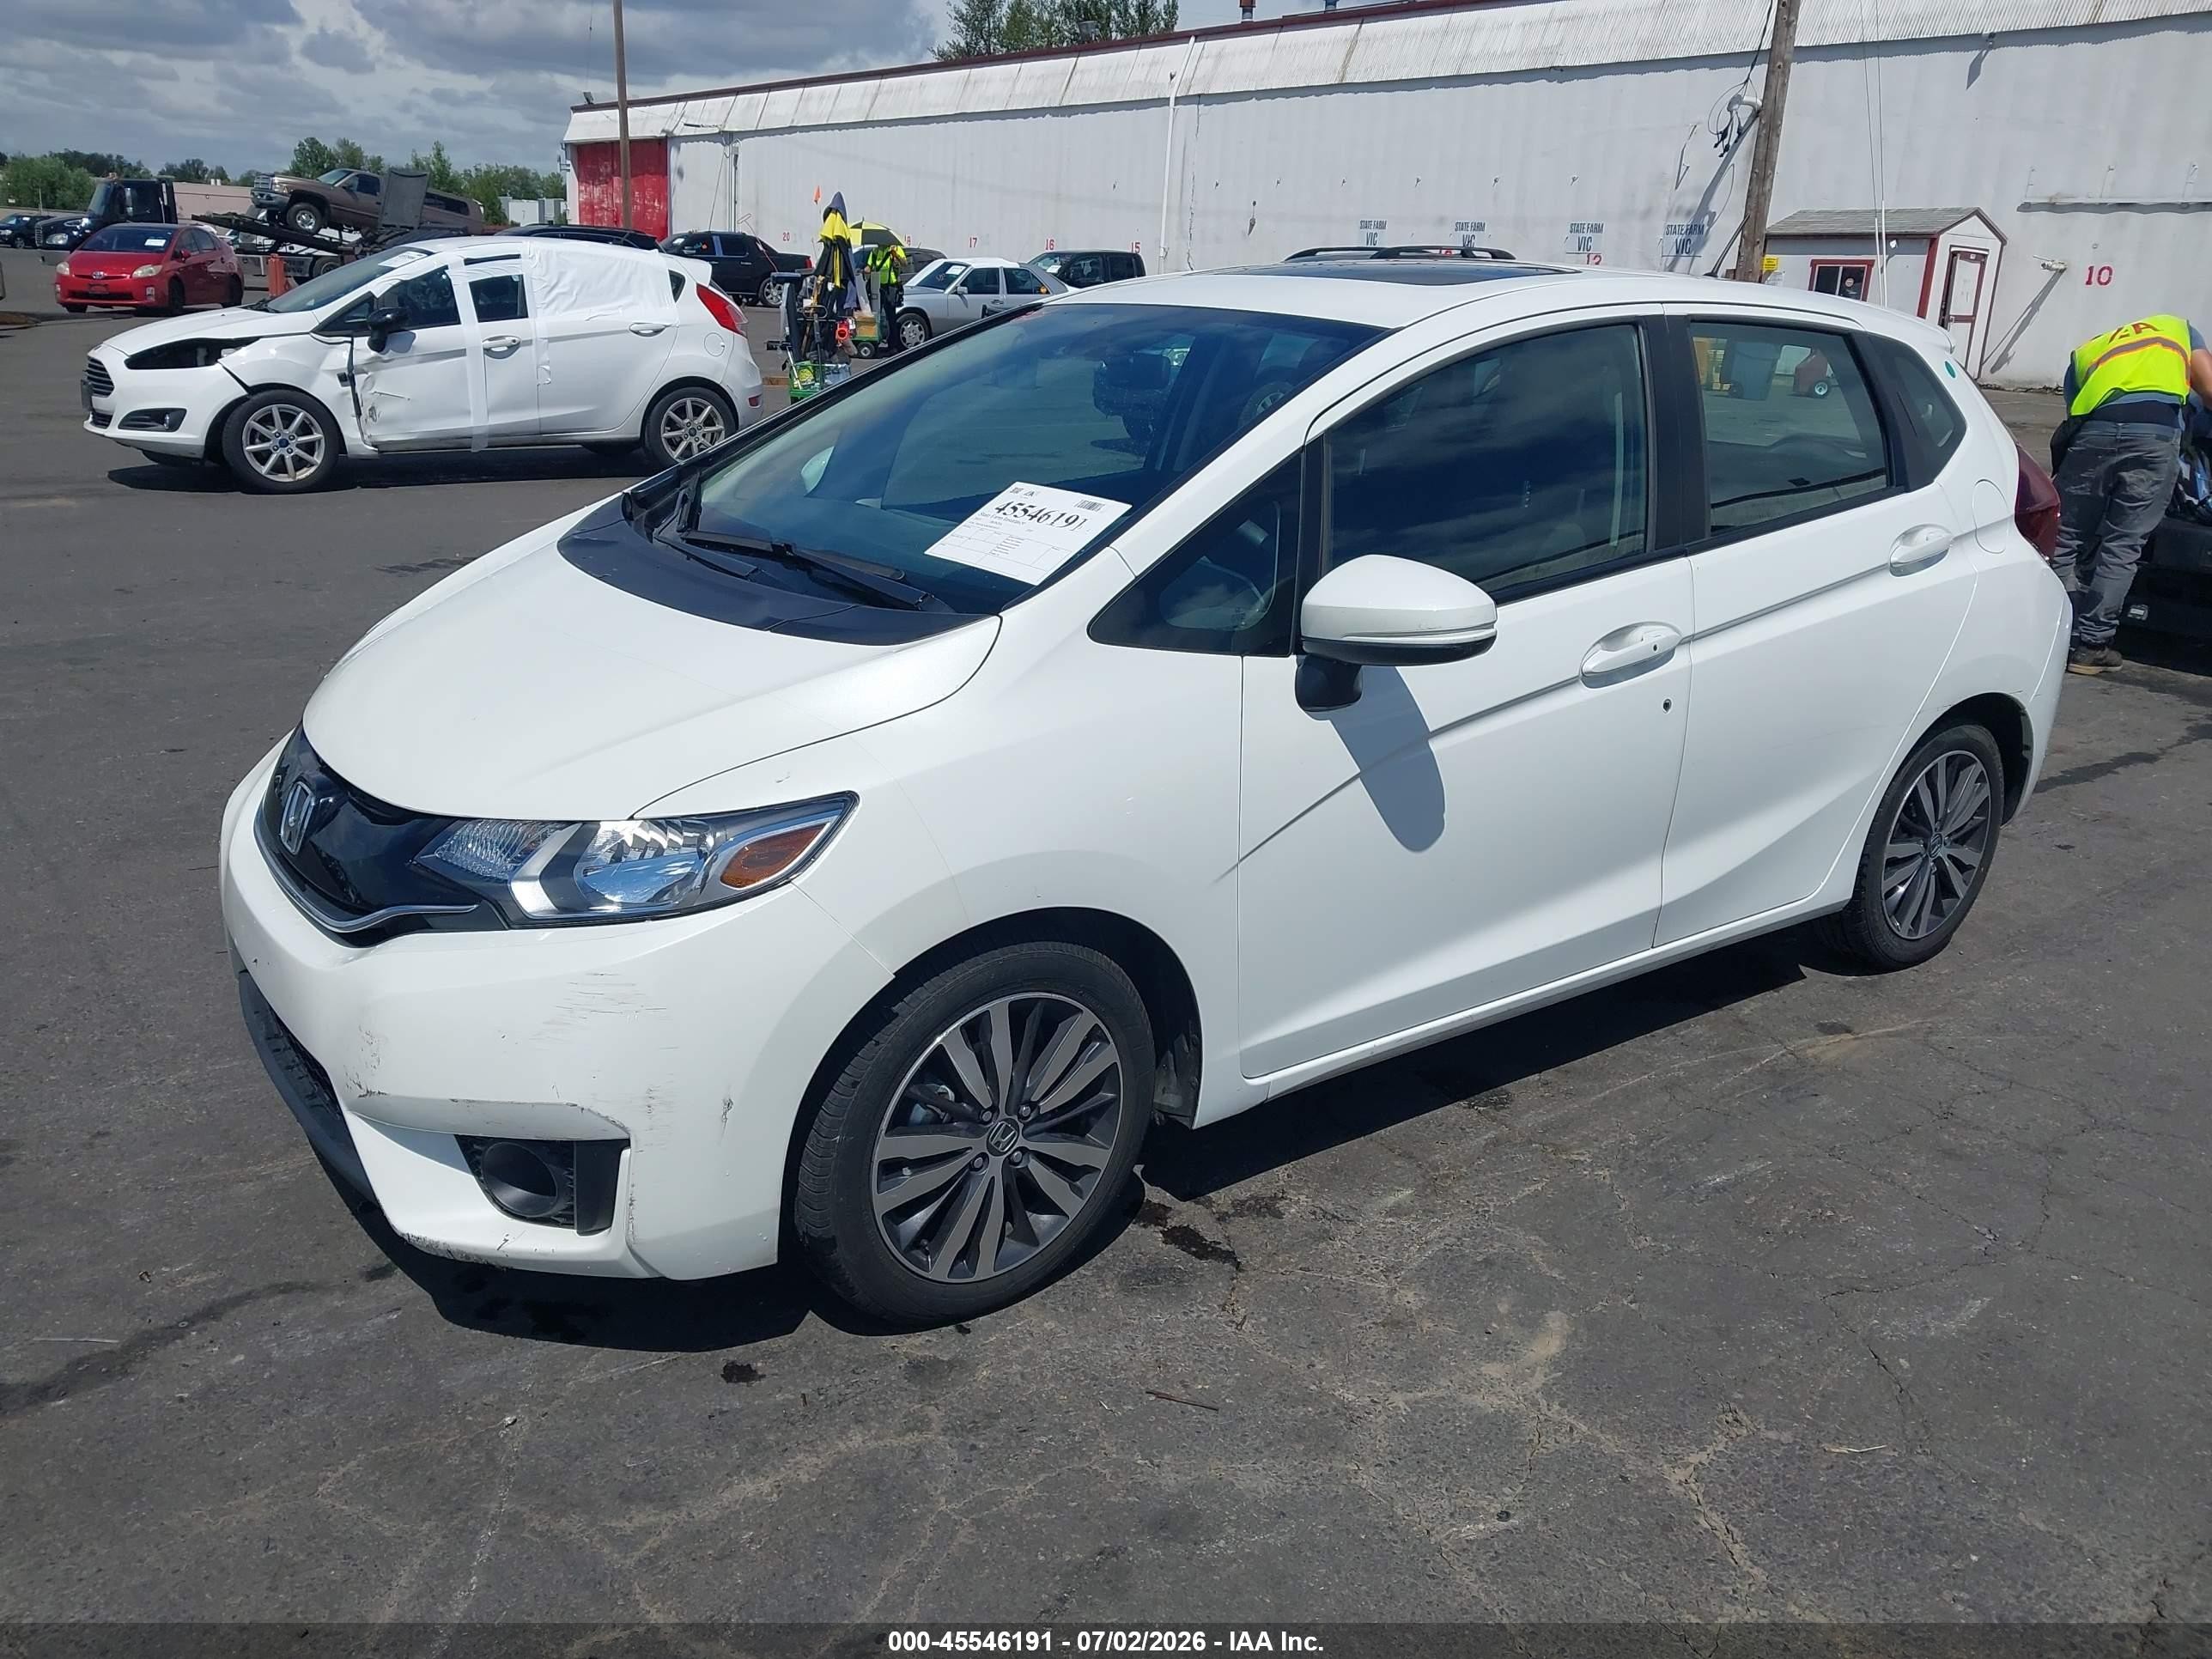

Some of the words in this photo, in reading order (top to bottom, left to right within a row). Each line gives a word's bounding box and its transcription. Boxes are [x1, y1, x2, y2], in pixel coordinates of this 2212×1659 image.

[1359, 220, 1373, 230] STATE
[1373, 220, 1387, 230] FARM
[1455, 222, 1470, 232] STATE
[1470, 222, 1486, 232] FARM
[1570, 222, 1586, 234] STATE
[1587, 223, 1603, 234] FARM
[1666, 224, 1685, 235] STATE
[1686, 223, 1705, 235] FARM
[782, 232, 790, 241] 20
[969, 237, 977, 248] 17
[1366, 232, 1378, 246] VIC
[1462, 234, 1476, 248] VIC
[1045, 239, 1054, 251] 16
[1131, 242, 1140, 253] 15
[1577, 236, 1593, 252] VIC
[1675, 238, 1692, 255] VIC
[2085, 265, 2113, 286] 10
[995, 501, 1088, 532] 45546191
